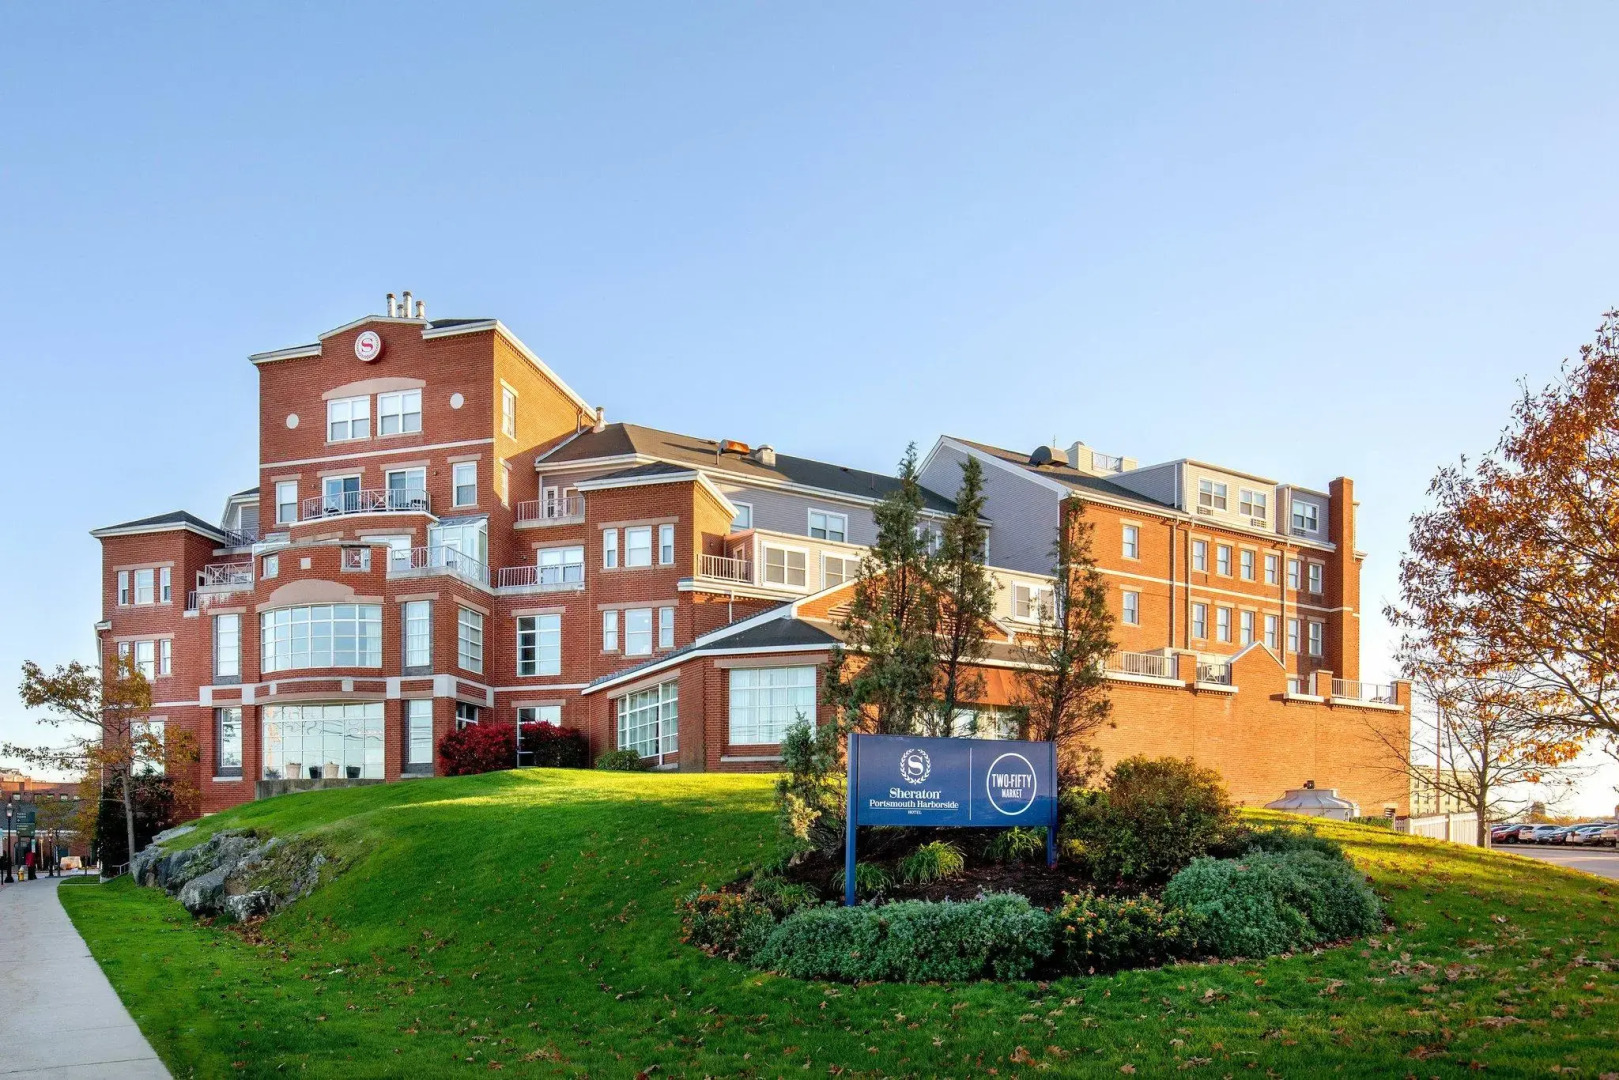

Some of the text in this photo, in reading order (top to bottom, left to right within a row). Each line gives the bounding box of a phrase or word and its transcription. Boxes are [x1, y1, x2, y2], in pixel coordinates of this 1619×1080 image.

[361, 338, 374, 352] S
[907, 754, 924, 776] S
[991, 773, 1032, 788] TWO-FIFTY
[889, 787, 942, 799] Sheraton
[1001, 788, 1022, 799] MARKET
[869, 799, 959, 809] Portsmouth Harborside
